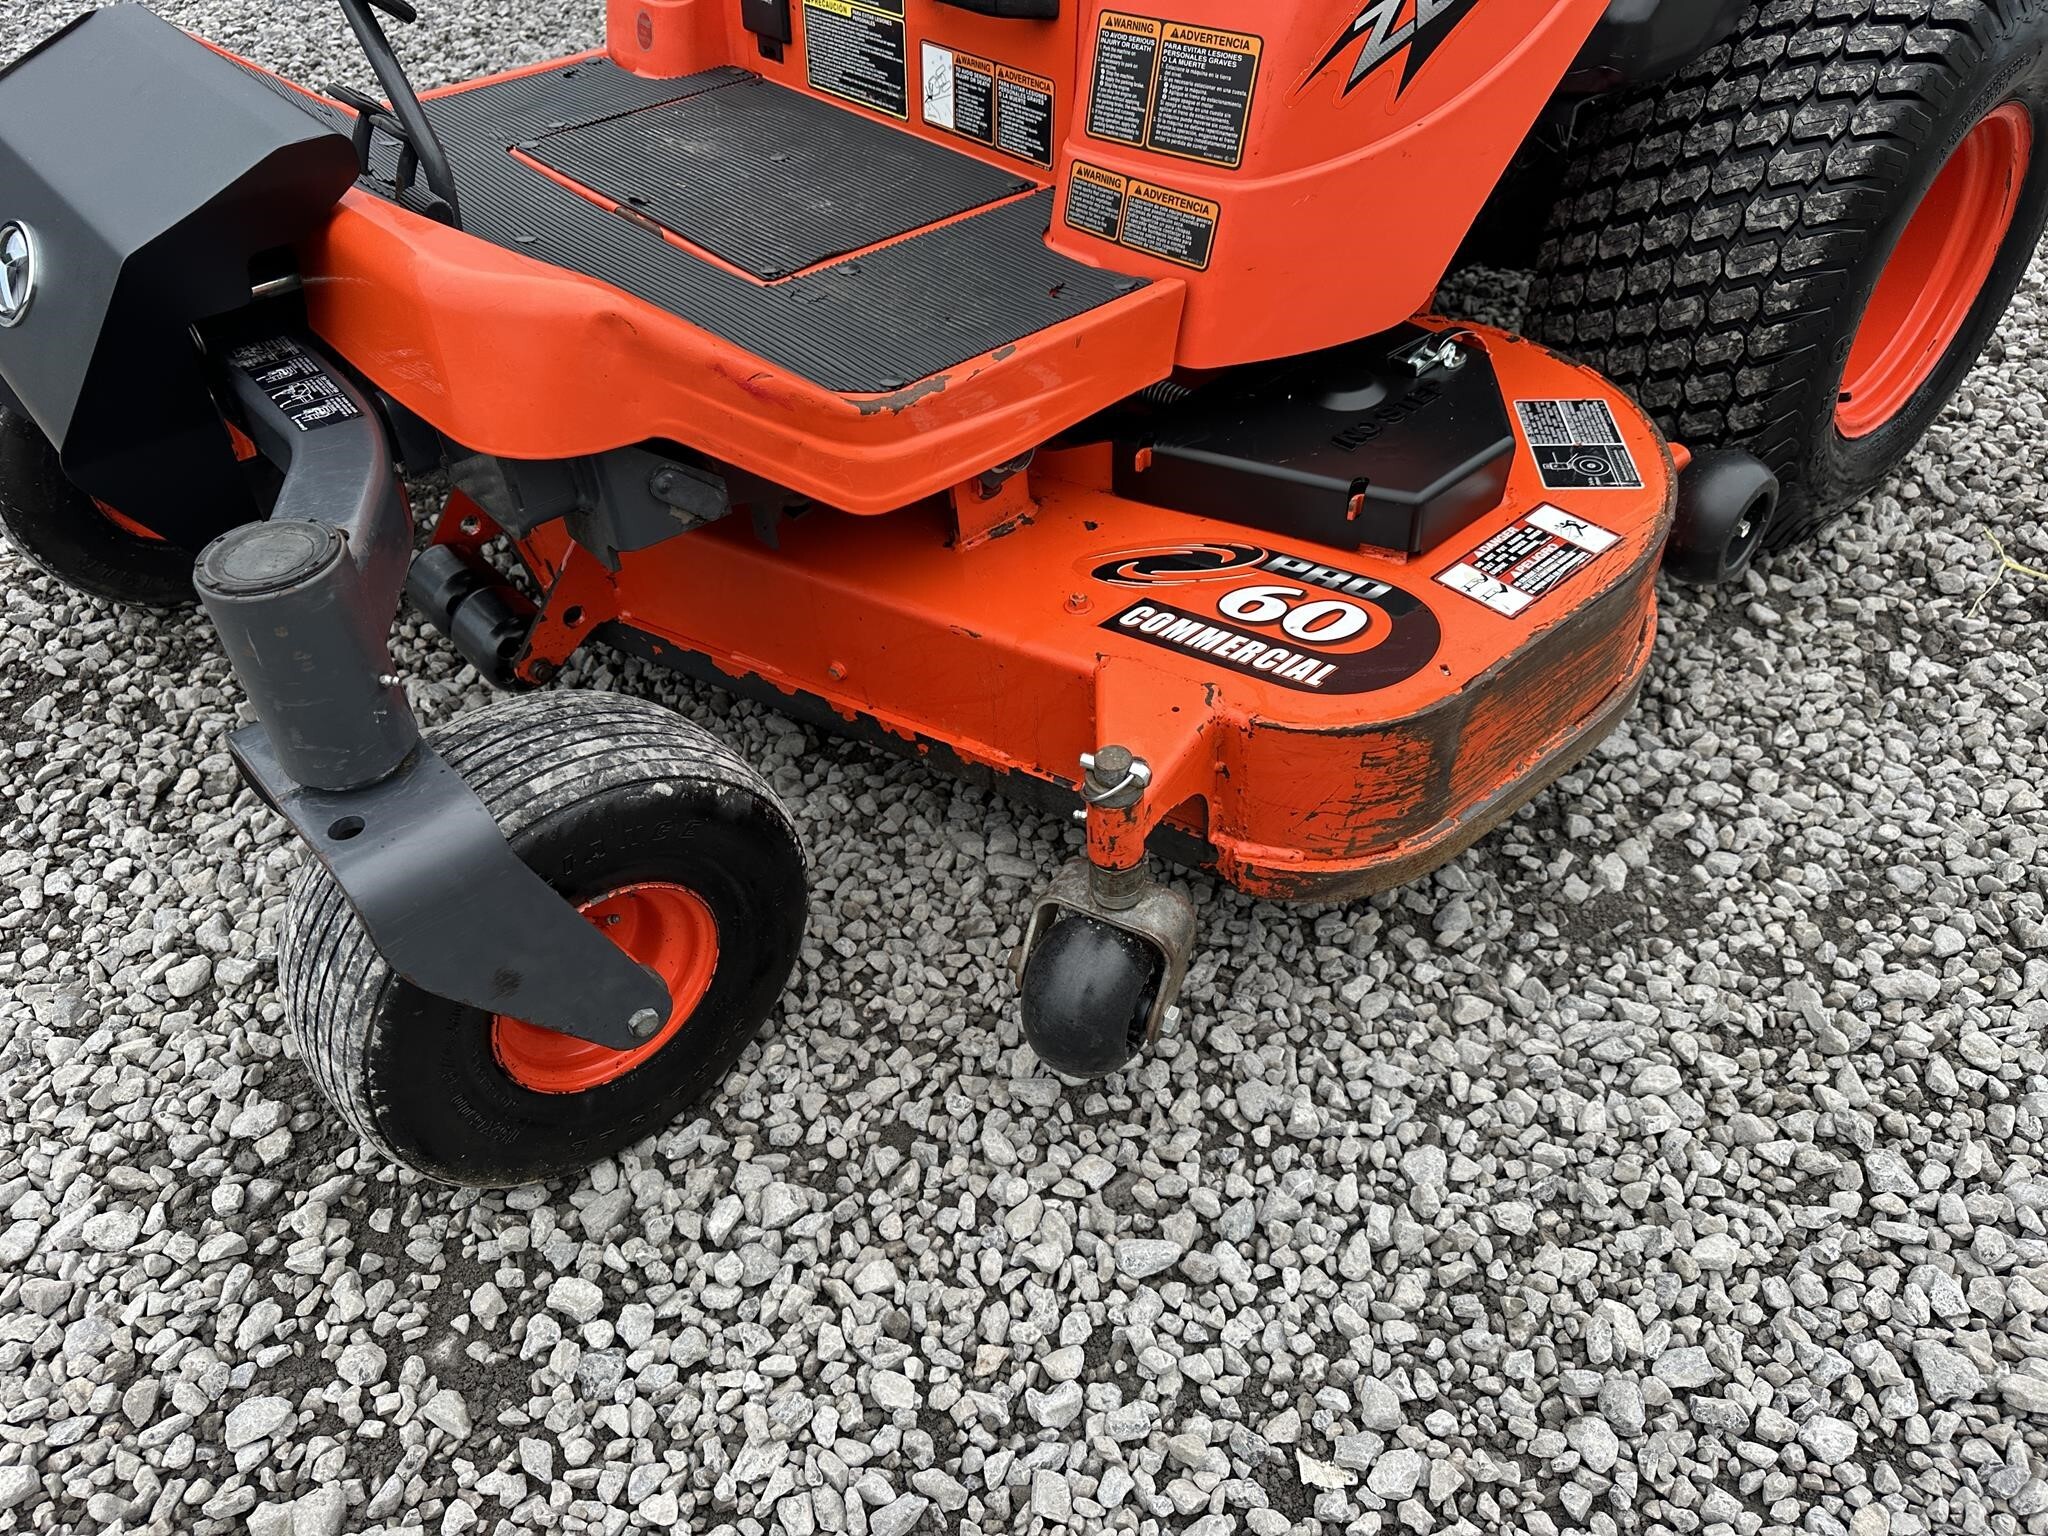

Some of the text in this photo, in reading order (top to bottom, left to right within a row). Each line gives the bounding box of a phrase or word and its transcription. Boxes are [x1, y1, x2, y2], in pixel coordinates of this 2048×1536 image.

[1112, 17, 1154, 34] WARNING
[1101, 37, 1120, 46] INJURY
[1131, 43, 1151, 52] DEATH
[1110, 32, 1127, 40] AVOID
[1128, 36, 1155, 46] SERIOUS
[1180, 30, 1250, 50] ADVERTENCIA
[1163, 49, 1237, 68] PERSONALES GRAVES
[1164, 42, 1243, 62] PARA EVITAR LESIONES
[961, 56, 990, 72] WARNING
[1178, 59, 1206, 70] MUERTE
[1005, 70, 1051, 92] ADVERTENCIA
[1083, 168, 1121, 188] WARNING
[1143, 188, 1209, 215] ADVERTENCIA
[1479, 526, 1520, 555] DANGER
[1516, 542, 1558, 572] PELIGRO
[1262, 554, 1393, 599] PRO
[1218, 585, 1369, 642] 60
[1118, 606, 1338, 688] COMMERCIAL
